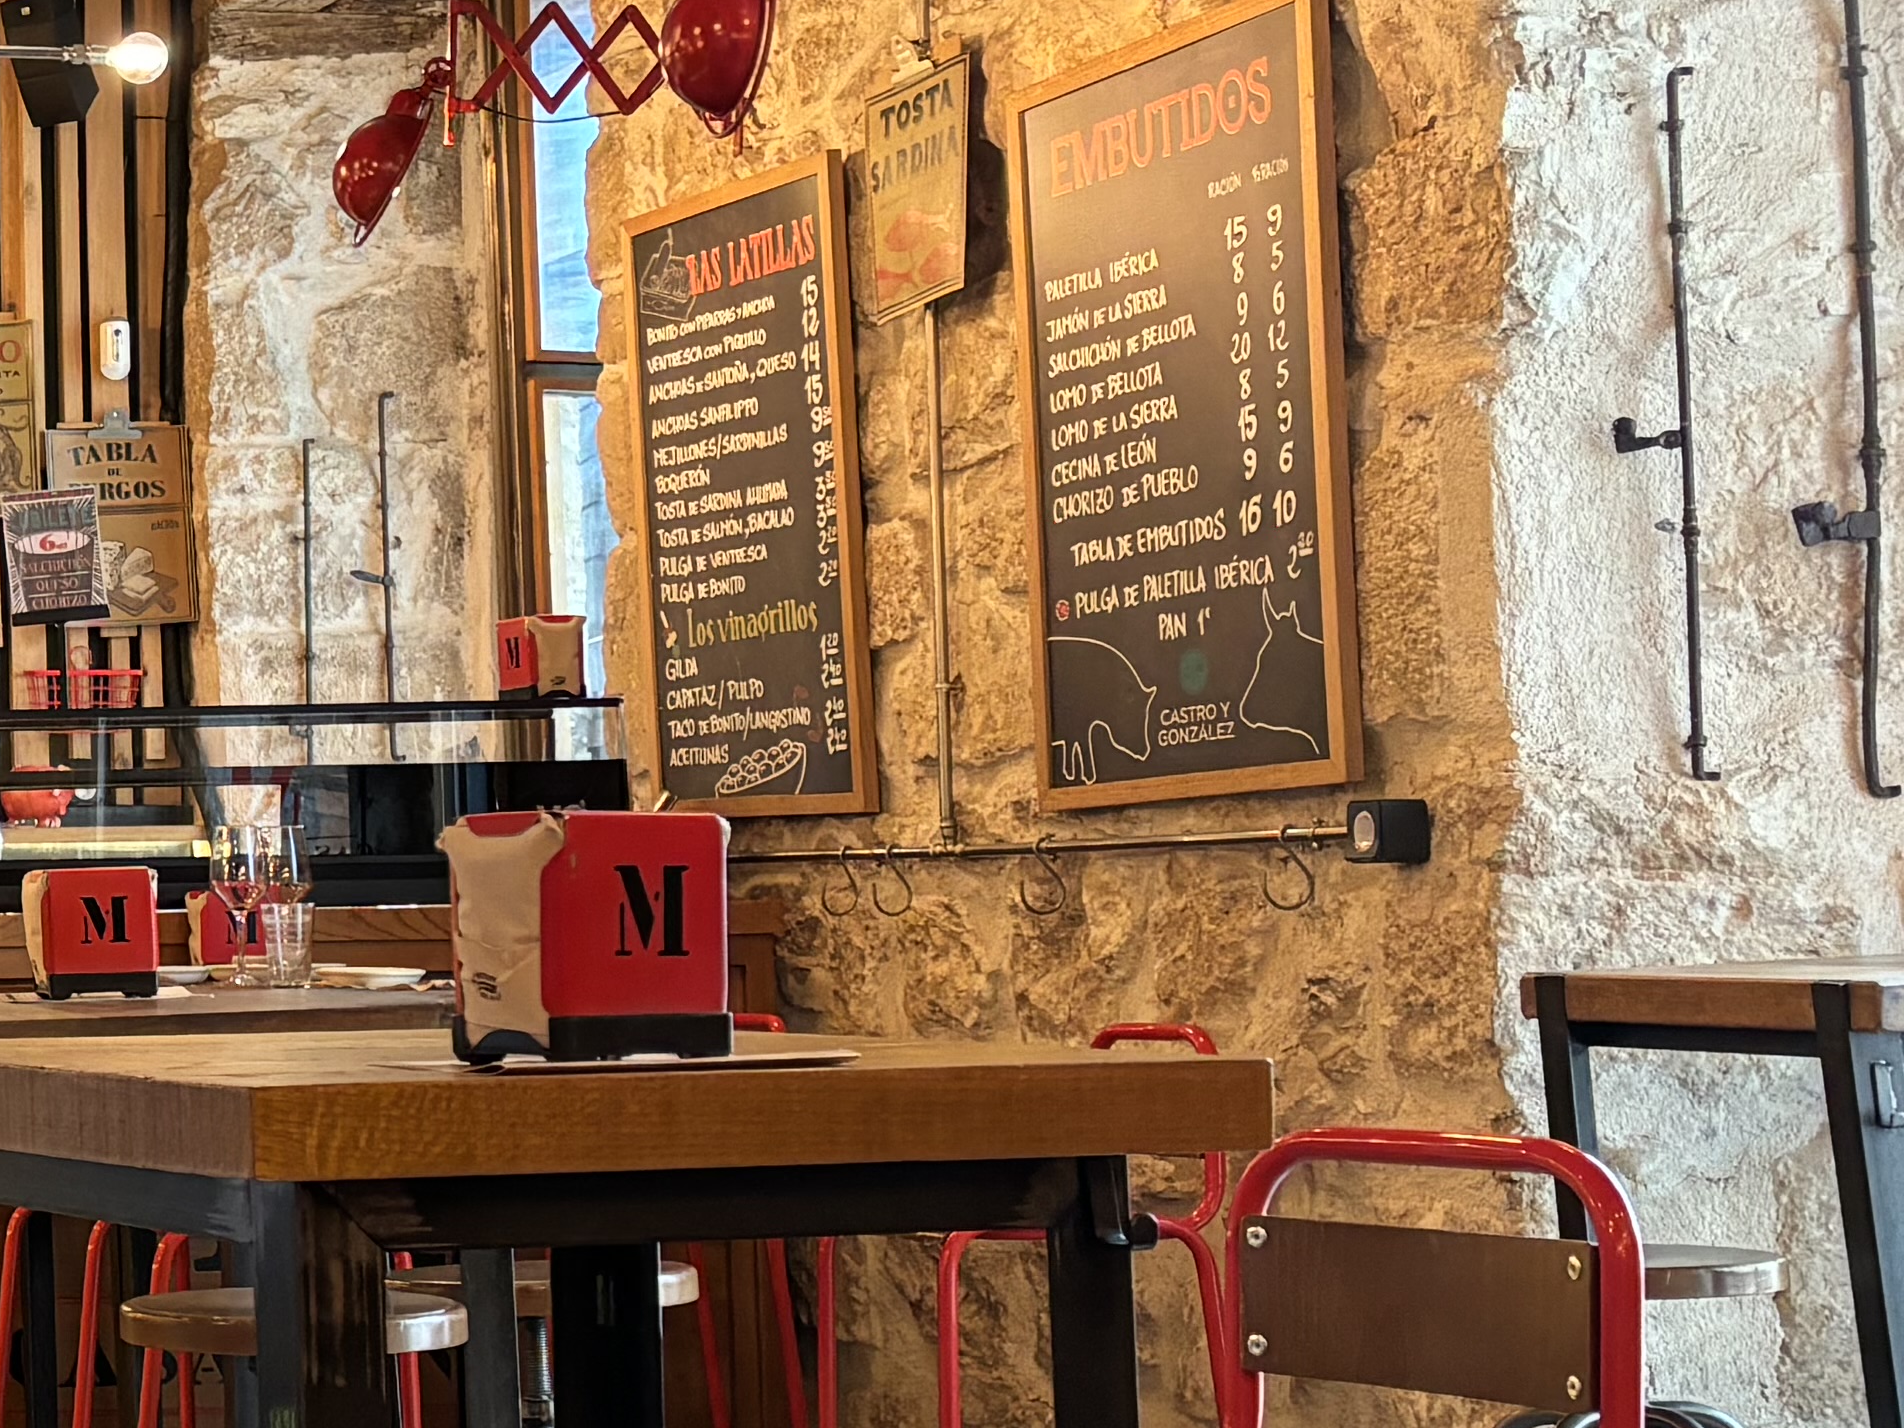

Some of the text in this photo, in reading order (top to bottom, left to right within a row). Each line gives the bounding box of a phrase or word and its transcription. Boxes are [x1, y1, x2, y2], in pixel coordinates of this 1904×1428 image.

[879, 78, 954, 140] TOSTA
[1050, 55, 1273, 199] EMBUTIDOS
[870, 124, 960, 195] SARDINA
[685, 214, 816, 296] LAS LATILLAS
[1044, 203, 1283, 303] PALETILLA IBÉRICA 15 9
[646, 322, 679, 346] BONITO
[800, 274, 819, 308] 15
[1045, 240, 1284, 343] JAMÓN DE LA SIERRA 8 5
[647, 347, 702, 374] VENTRESCA
[722, 328, 766, 353] PIQUILLO
[801, 307, 820, 338] 12
[1047, 280, 1286, 378] SALCHICHÓN DE BELLOTA 9 6
[649, 376, 695, 405] ANCHOAS
[756, 351, 797, 378] QUESO
[800, 340, 820, 372] 14
[1050, 319, 1290, 414] LOMO DE BELLOTA 20 12
[651, 410, 698, 439] ANCHOAS
[804, 374, 824, 405] 15
[1051, 358, 1290, 452] LOMO DE LA SIERRA 8 5
[67, 441, 158, 467] TABLA
[1051, 399, 1293, 488] CECINA DE LEÓN 15 9
[68, 479, 166, 500] RGOS
[655, 464, 710, 494] BOQUERÓN
[655, 499, 687, 521] TOSTA
[700, 489, 743, 514] SARDINA
[1053, 440, 1294, 524] CHORIZO DE PUEBLO 9 6
[657, 528, 689, 549] TOSTA
[749, 506, 794, 534] BACALAO
[1070, 489, 1296, 567] TABLA DE EMBUTIDOS 16 10
[36, 578, 78, 591] QUESO
[659, 544, 768, 577] PULGA DE VENTRESCA
[1075, 555, 1274, 620] PULGA DE PALETILLA IBÉRICA
[32, 594, 87, 610] CHORIZO
[660, 576, 746, 605] PULGA DE BONITO
[686, 608, 715, 648] Los
[1158, 611, 1187, 641] PAN
[665, 657, 698, 682] GILDA
[726, 679, 764, 701] PULPO
[668, 718, 695, 740] TACO
[1158, 721, 1236, 747] GONZÁLEZ
[1160, 701, 1230, 727] CASTRO Y
[669, 743, 729, 767] ACEITUNAS
[78, 895, 131, 944] M
[612, 864, 691, 957] M
